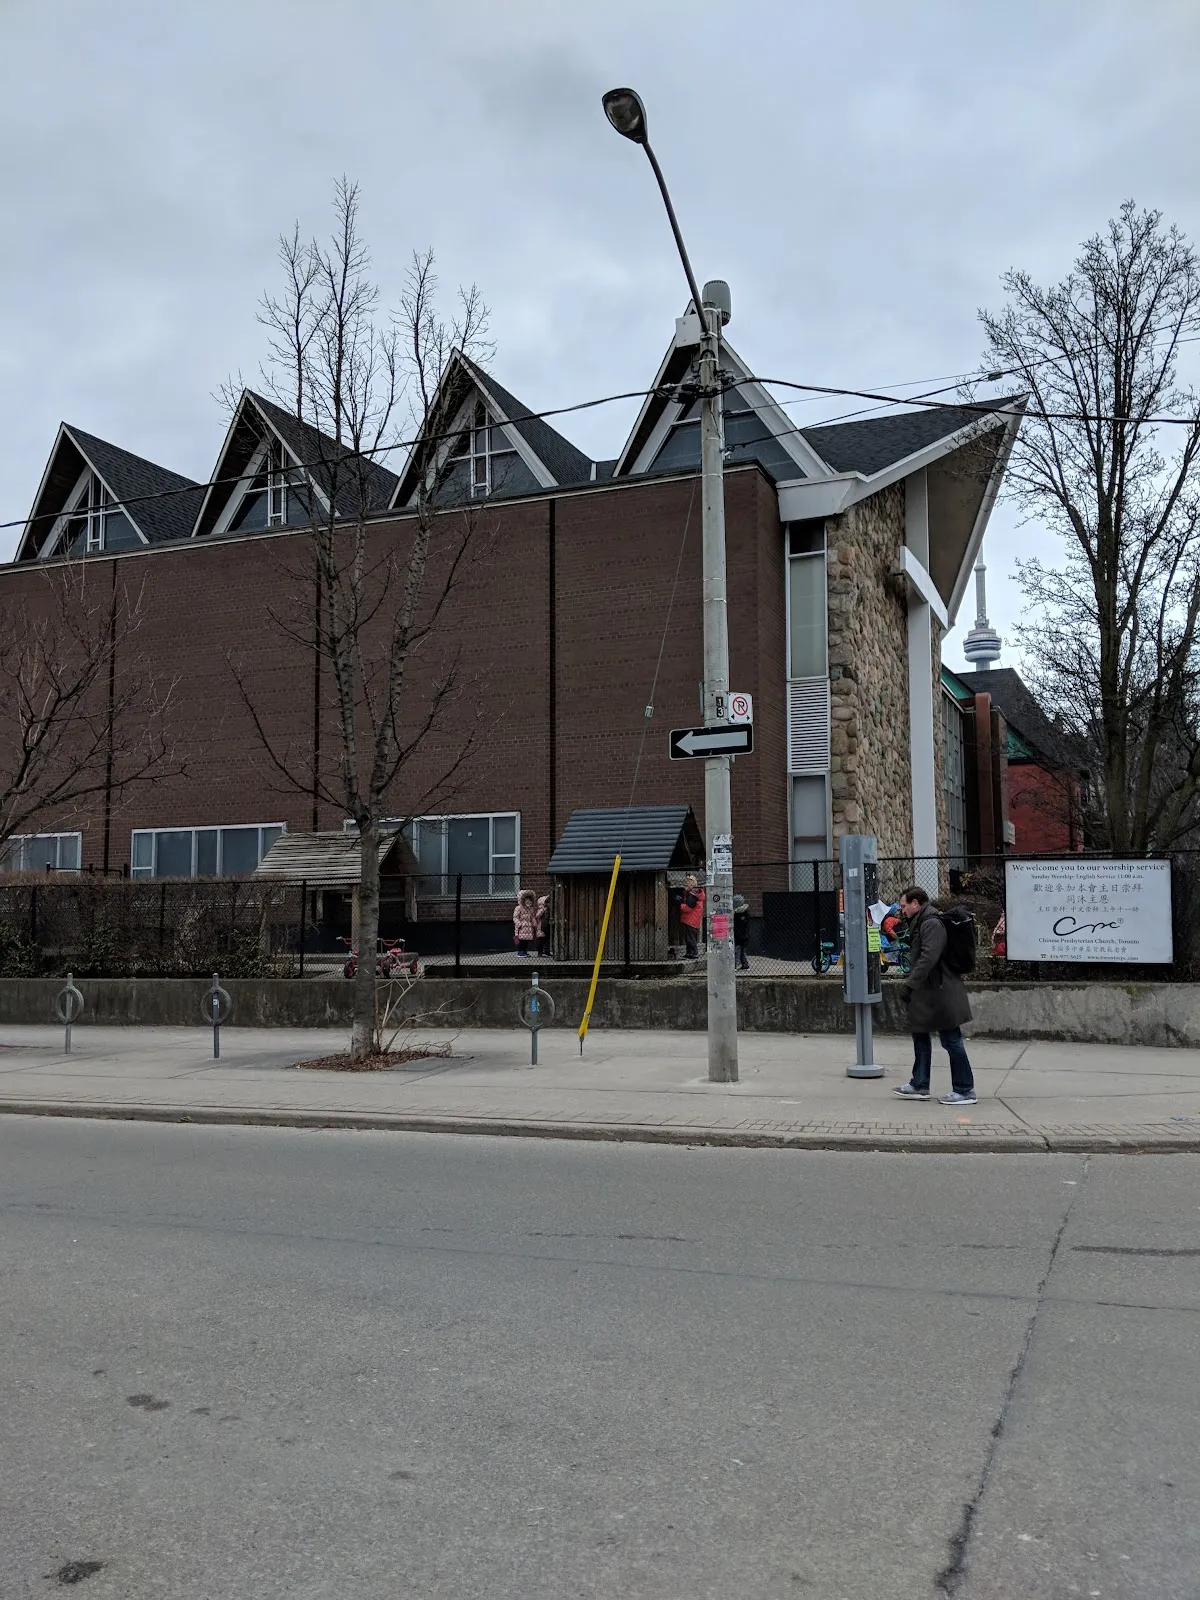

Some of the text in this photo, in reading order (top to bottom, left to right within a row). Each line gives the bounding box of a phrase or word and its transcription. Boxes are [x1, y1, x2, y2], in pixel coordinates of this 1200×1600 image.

[1102, 863, 1135, 872] worship
[1136, 863, 1165, 871] service
[1067, 894, 1109, 904] 同沐主恩
